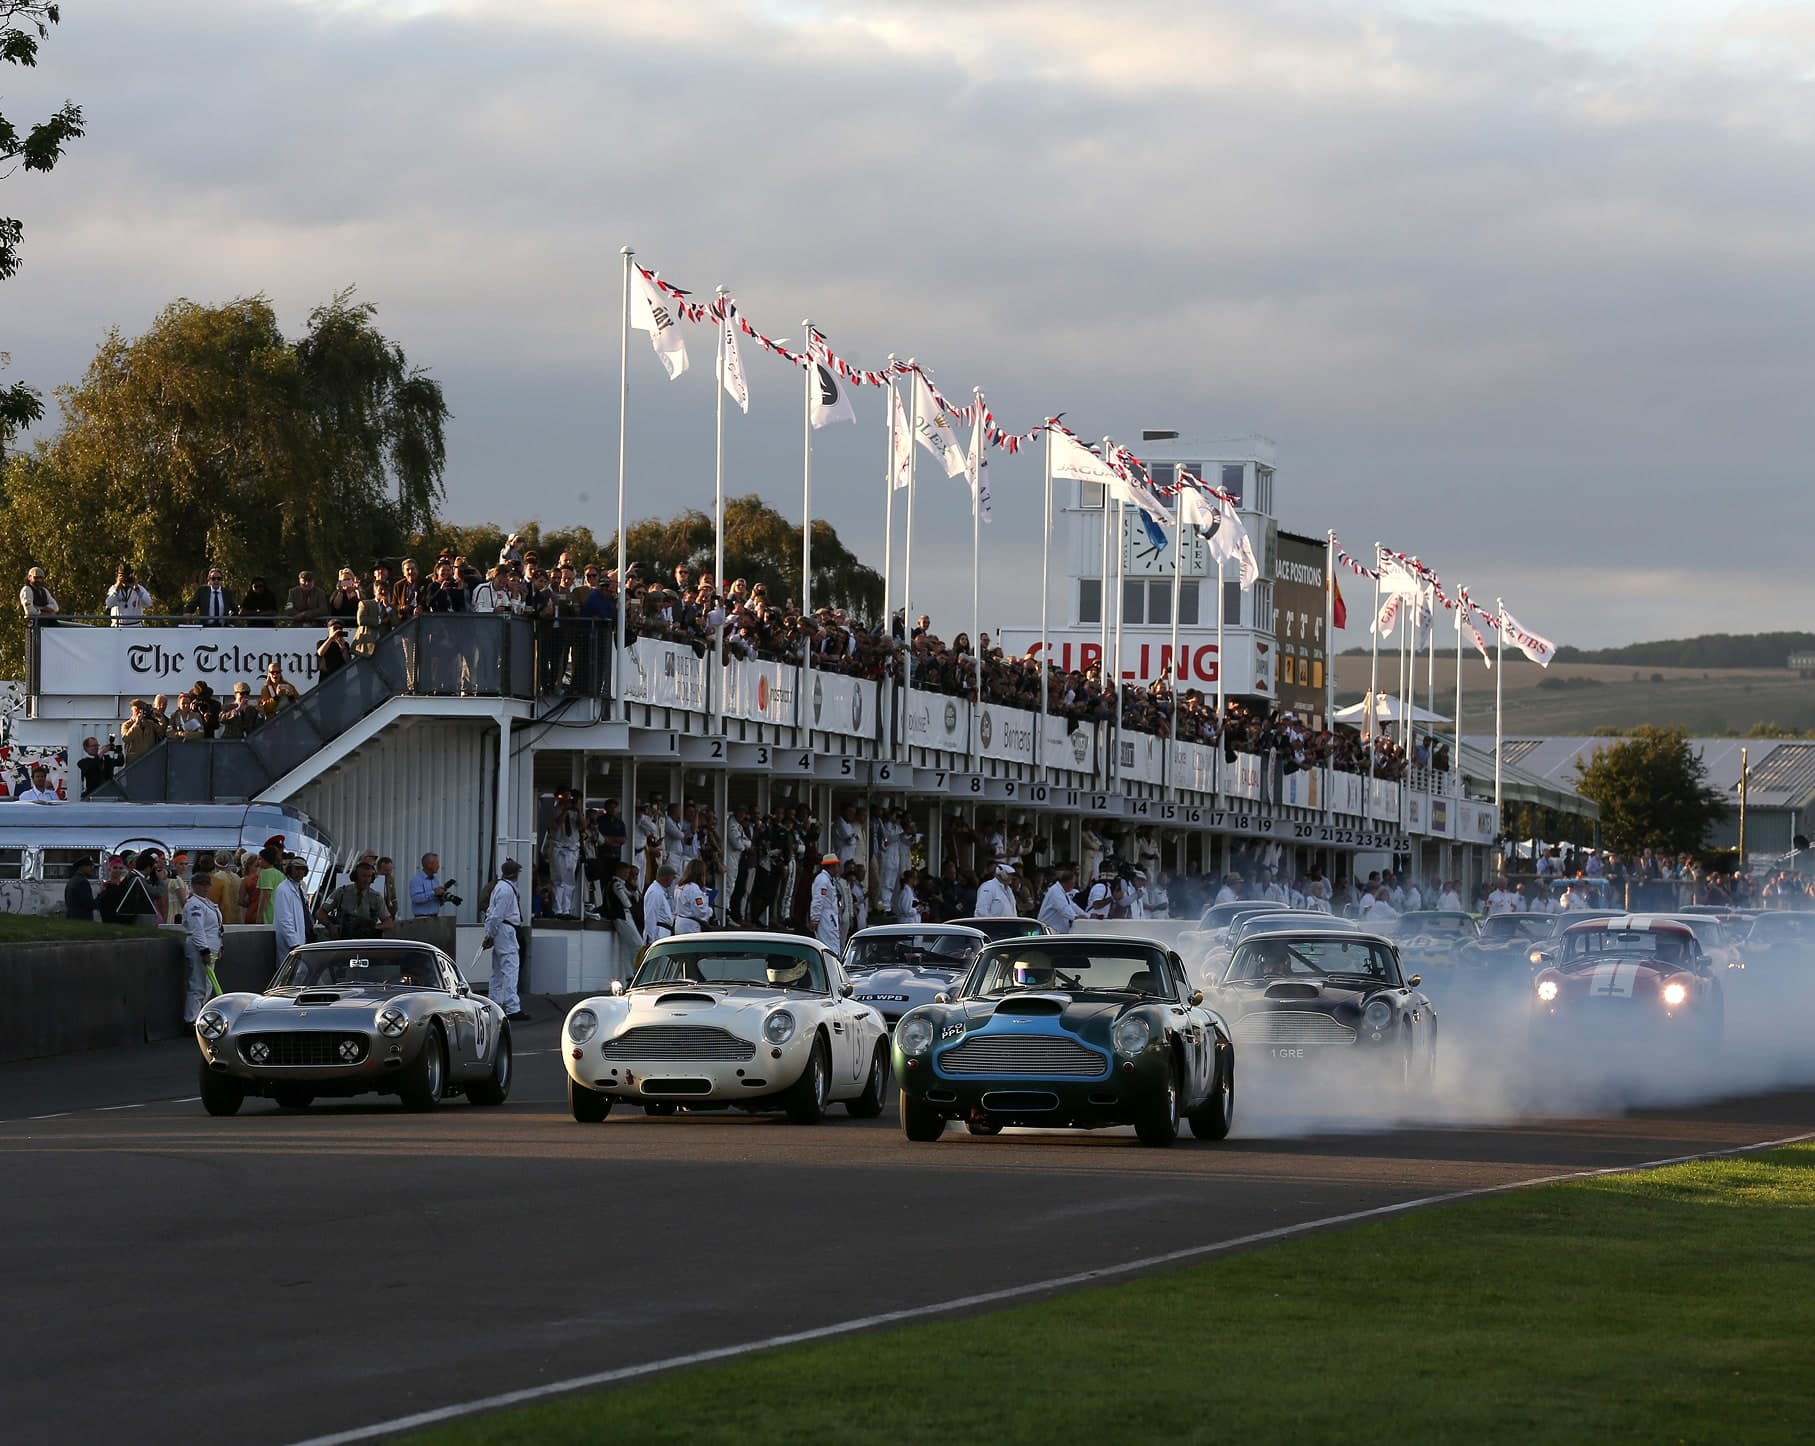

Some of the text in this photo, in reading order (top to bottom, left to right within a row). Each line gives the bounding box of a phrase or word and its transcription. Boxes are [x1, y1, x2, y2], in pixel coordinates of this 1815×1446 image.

[914, 416, 947, 456] OLEX
[1057, 464, 1115, 478] JAGUA
[1290, 562, 1322, 588] POSITIONS
[1516, 633, 1549, 655] UBS
[127, 644, 319, 680] The Telegrap
[670, 734, 675, 751] 1
[711, 741, 723, 758] 2
[757, 748, 768, 764] 3
[798, 754, 810, 770] 4
[841, 759, 851, 775] 5
[879, 764, 890, 780] 6
[936, 773, 945, 788] 7
[970, 777, 981, 792] 8
[1005, 782, 1015, 797] 9
[1030, 787, 1046, 801] 10
[1066, 791, 1077, 805] 11
[1091, 796, 1106, 809] 12
[1132, 801, 1147, 814] 14
[1161, 806, 1175, 818] 15
[1186, 810, 1200, 822] 16
[1210, 813, 1224, 826] 17
[1234, 817, 1249, 829] 18
[1258, 820, 1272, 832] 19
[1295, 825, 1312, 837] 20
[1320, 829, 1333, 841] 21
[1336, 831, 1353, 843] 22
[1356, 835, 1373, 846] 23
[1374, 837, 1391, 848] 24
[1394, 840, 1410, 851] 25
[1271, 1049, 1304, 1058] 1 GRE
